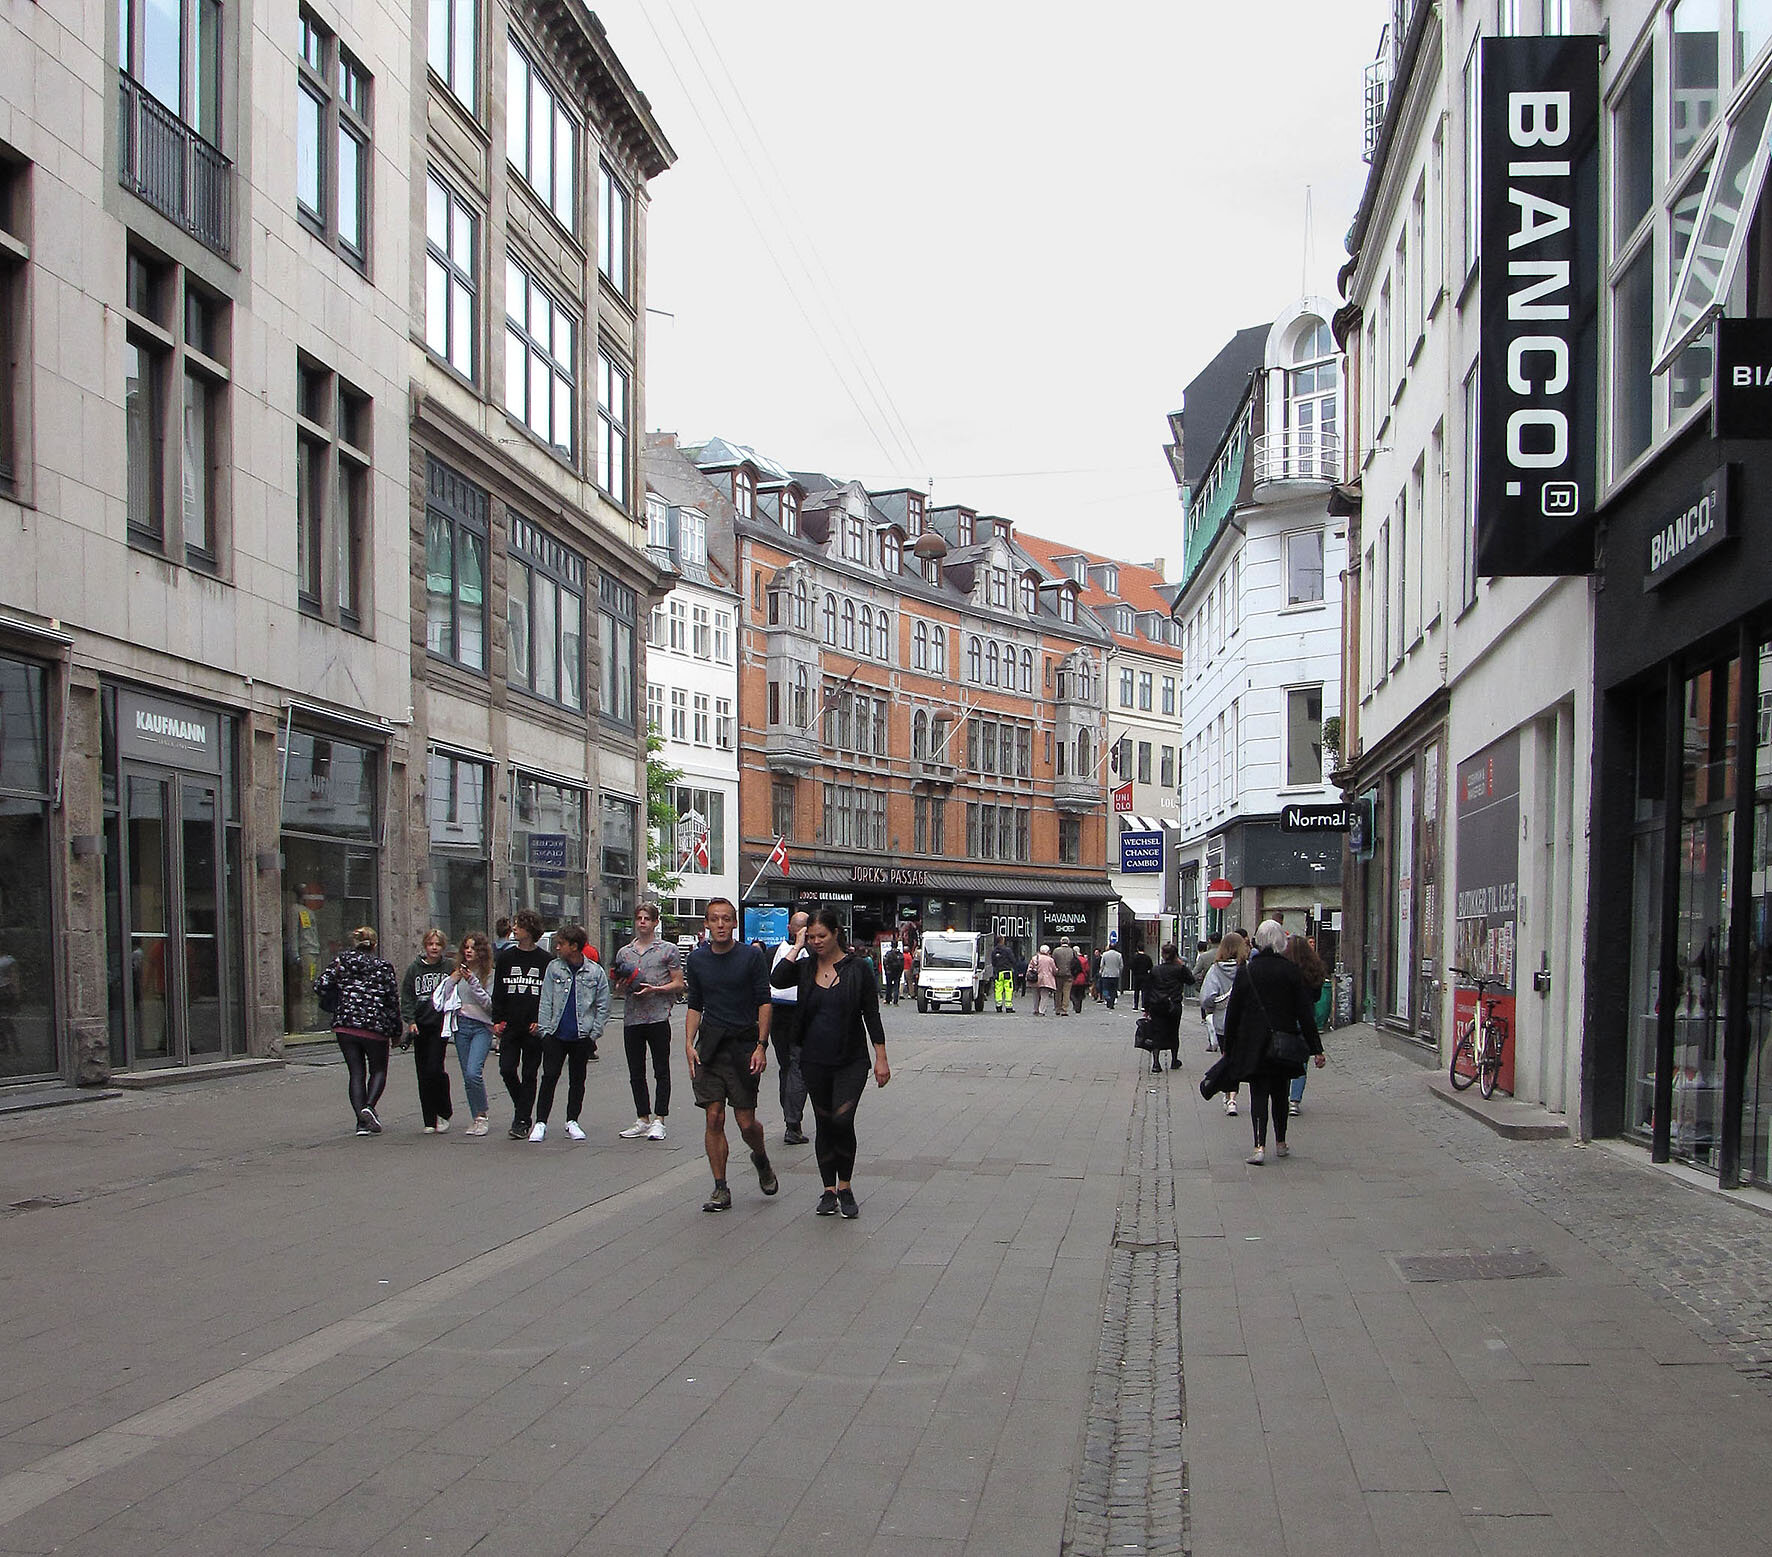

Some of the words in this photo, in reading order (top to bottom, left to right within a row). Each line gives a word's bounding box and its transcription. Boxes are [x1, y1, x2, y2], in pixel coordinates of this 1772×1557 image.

[1507, 91, 1570, 496] BIANCO.
[136, 710, 206, 744] KAUFMANN
[1115, 793, 1131, 802] UNI
[1115, 802, 1132, 810] QLO
[1289, 809, 1346, 828] Normal
[1123, 838, 1160, 846] WECHSEL
[1125, 848, 1160, 857] CHANGE
[1126, 859, 1159, 868] CAMBIO
[1043, 909, 1087, 924] HAVANNA
